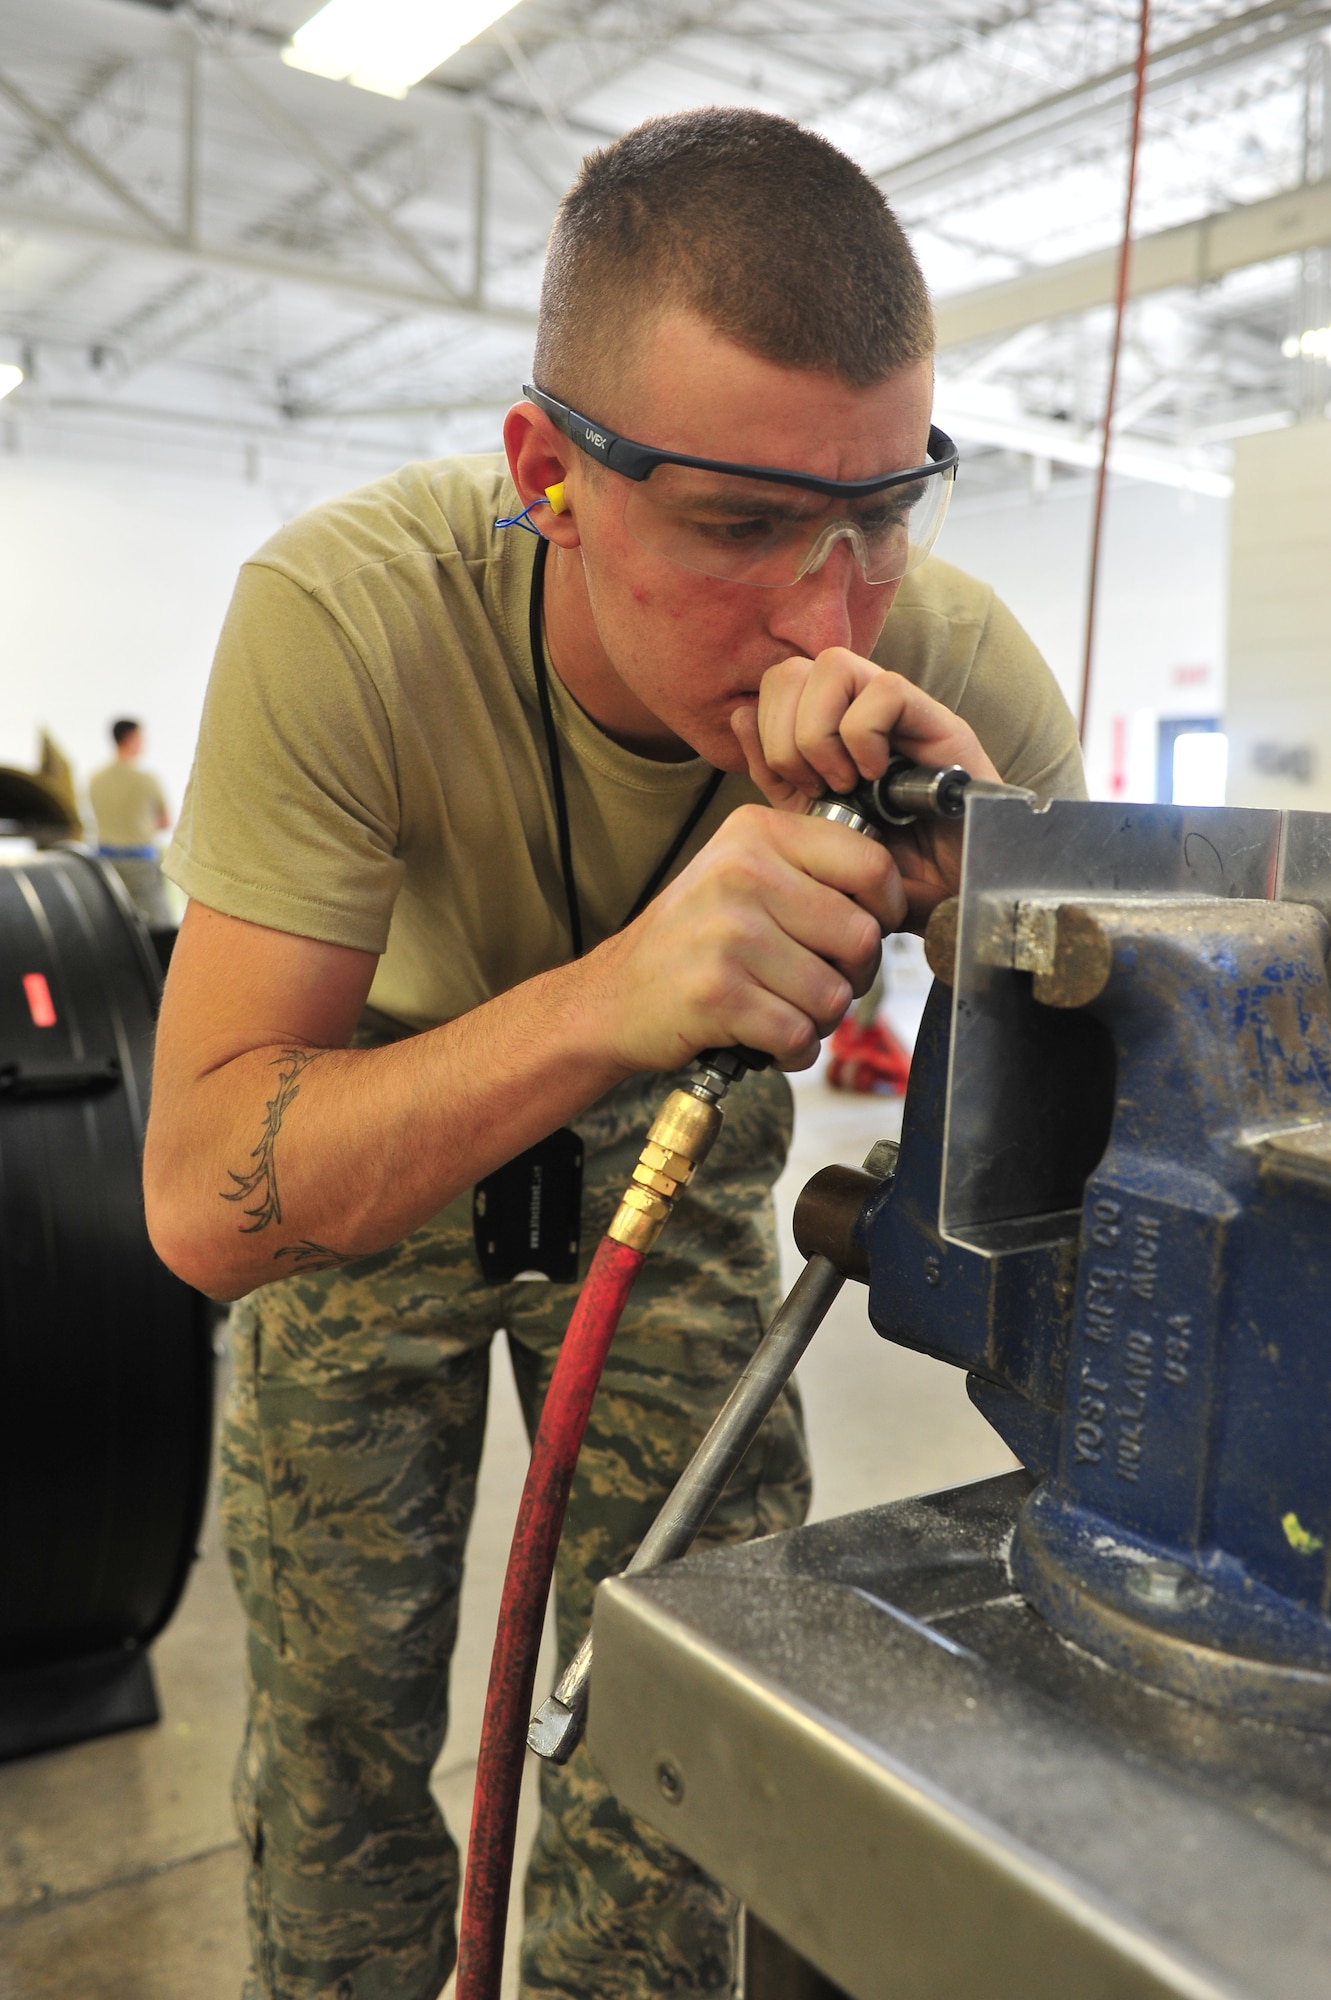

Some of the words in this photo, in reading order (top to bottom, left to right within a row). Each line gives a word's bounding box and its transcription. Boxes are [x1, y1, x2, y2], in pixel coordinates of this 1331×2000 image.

[585, 427, 607, 449] UVEX
[1130, 1214, 1161, 1300] MICH
[1164, 1313, 1192, 1386] USA
[1075, 1358, 1109, 1464] YOST
